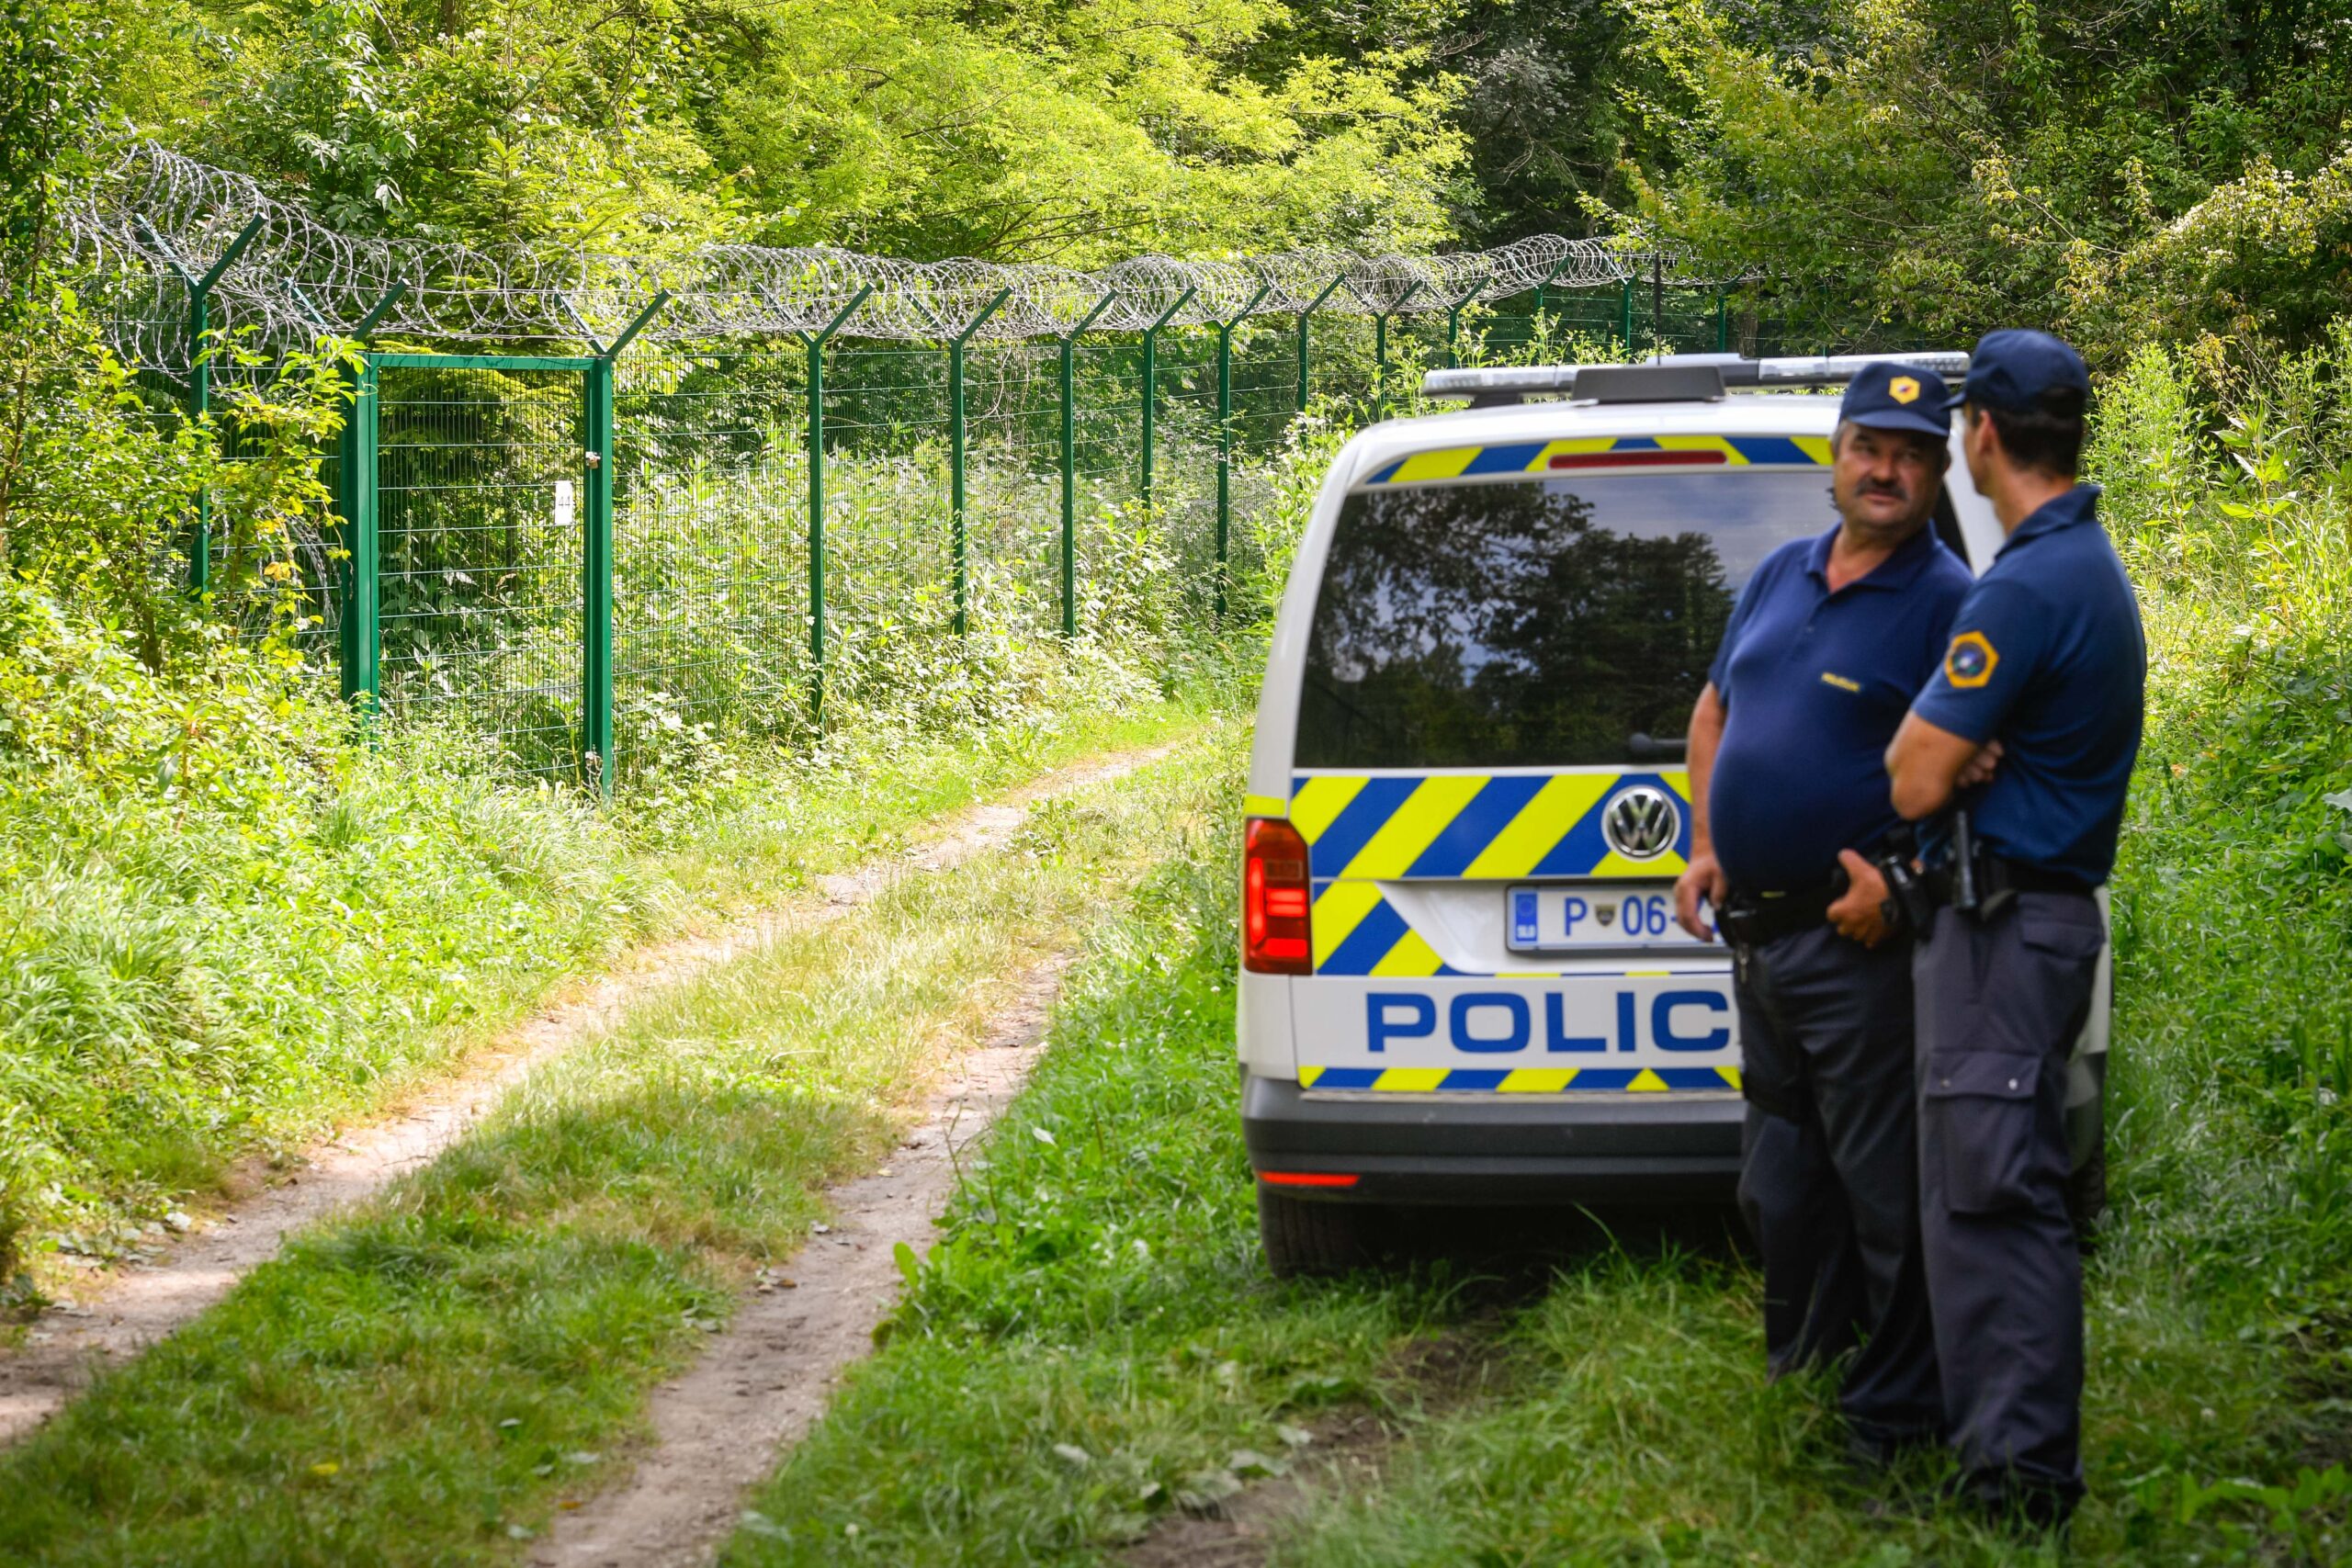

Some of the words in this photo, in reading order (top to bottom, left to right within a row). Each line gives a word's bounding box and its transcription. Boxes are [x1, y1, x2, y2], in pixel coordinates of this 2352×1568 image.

[558, 496, 571, 510] 44
[1564, 897, 1589, 936] P
[1367, 990, 1729, 1053] POLIC
